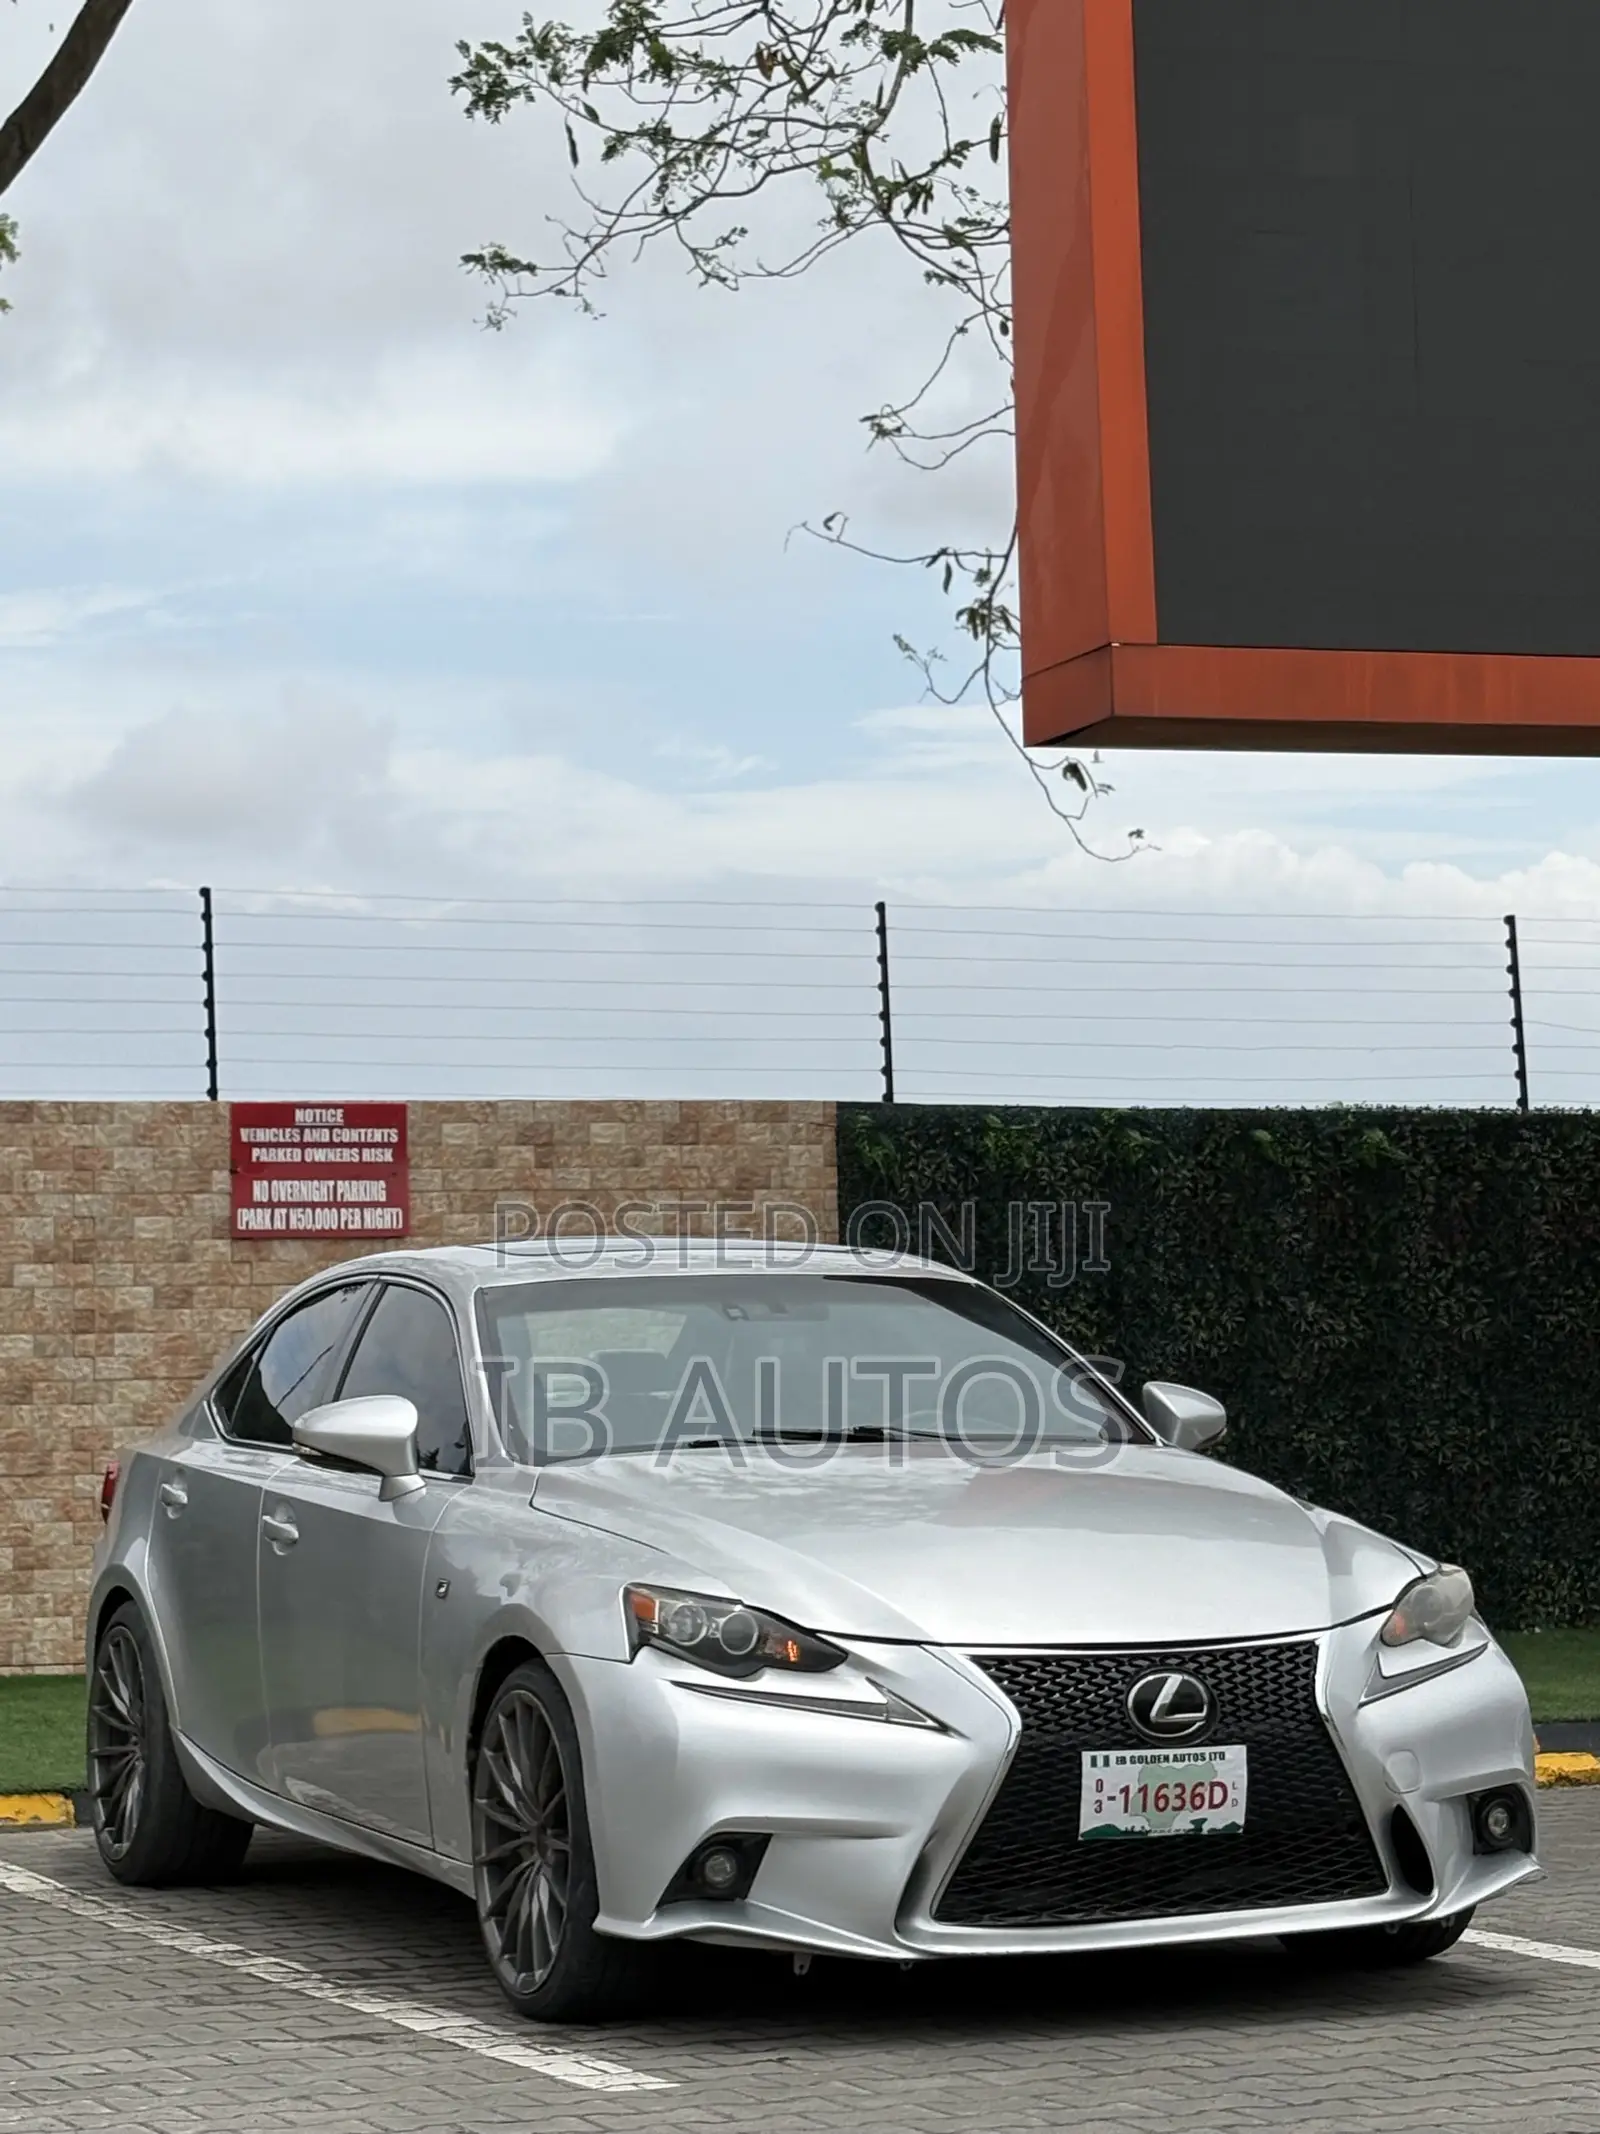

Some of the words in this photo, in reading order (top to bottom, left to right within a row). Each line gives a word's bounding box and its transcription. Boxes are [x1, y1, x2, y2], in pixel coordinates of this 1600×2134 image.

[295, 1108, 345, 1123] NOTICE
[240, 1128, 301, 1143] VEHICLES
[303, 1128, 330, 1143] AND
[332, 1128, 399, 1143] CONTENTS
[251, 1147, 302, 1163] PARKED
[304, 1147, 360, 1163] OWNERS
[362, 1147, 394, 1163] RISK
[252, 1180, 269, 1202] NO
[271, 1180, 335, 1203] OVERNIGHT
[337, 1180, 386, 1202] PARKING
[273, 1208, 287, 1230] AT
[340, 1208, 363, 1229] PER
[1130, 1754, 1170, 1765] GOLDEN
[1172, 1752, 1207, 1763] AUTOS
[1209, 1751, 1226, 1762] LTD
